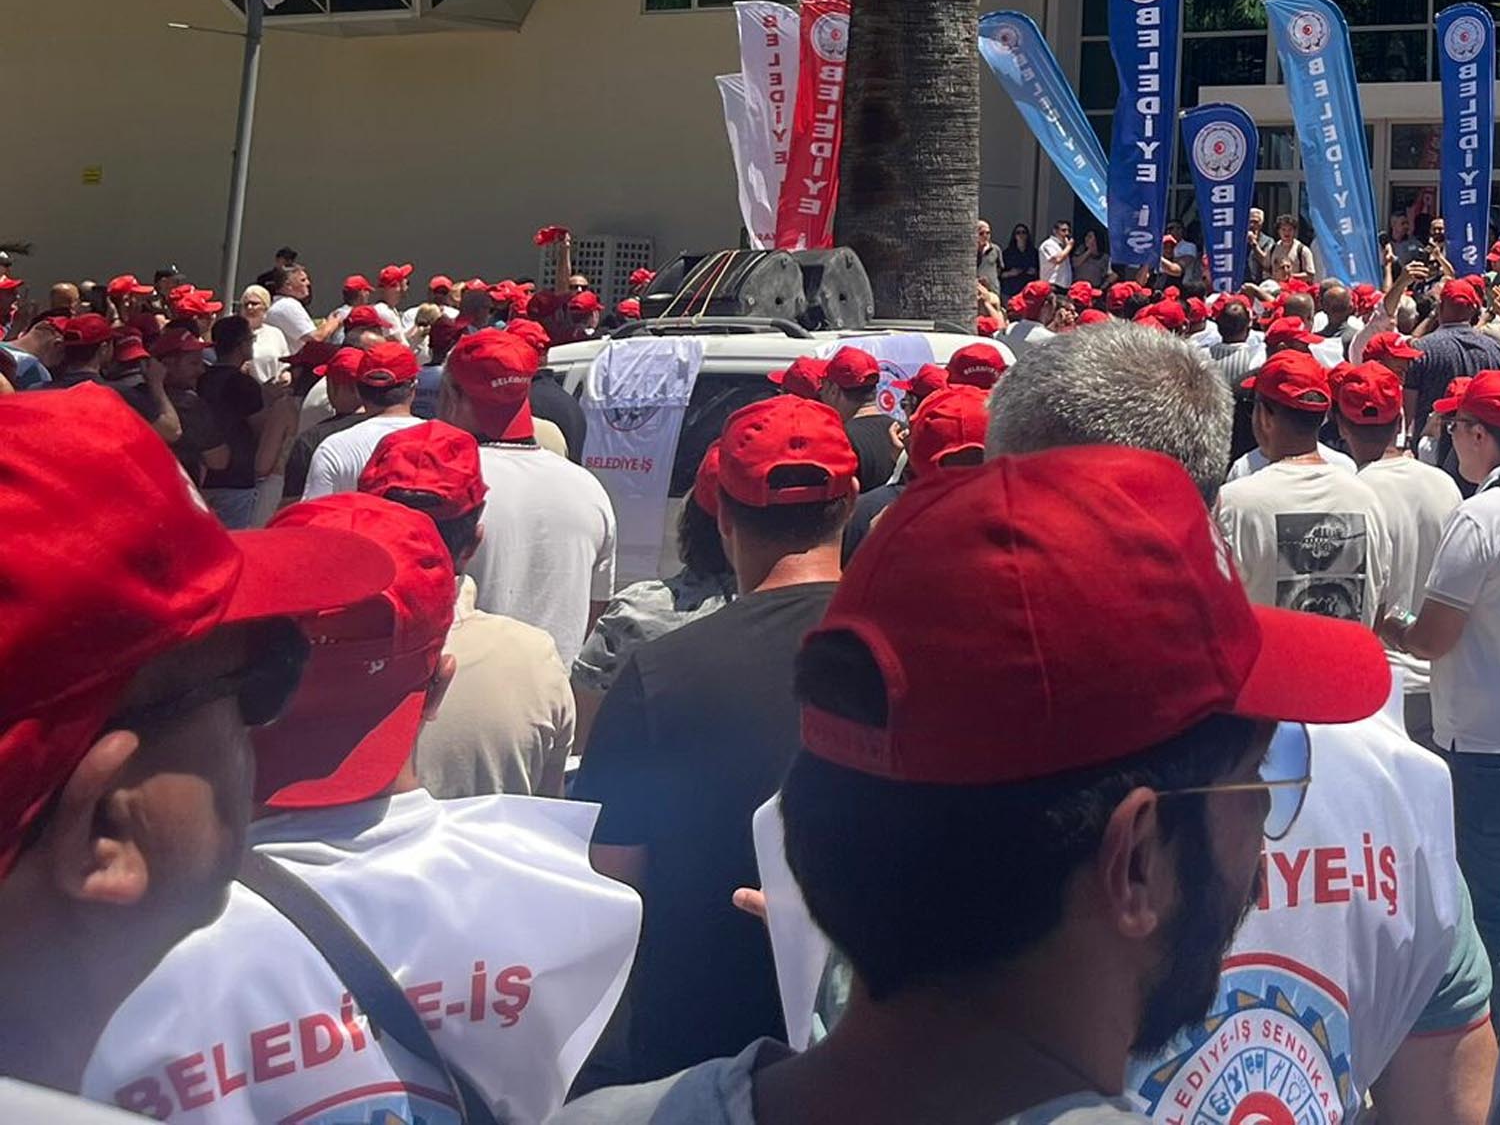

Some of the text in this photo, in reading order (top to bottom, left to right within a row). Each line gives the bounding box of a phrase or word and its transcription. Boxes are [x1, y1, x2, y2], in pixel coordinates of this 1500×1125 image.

[1258, 832, 1397, 916] İYE-İŞ
[114, 960, 532, 1122] BELEDİE-İŞ
[1262, 1019, 1339, 1125] SENDİKAS
